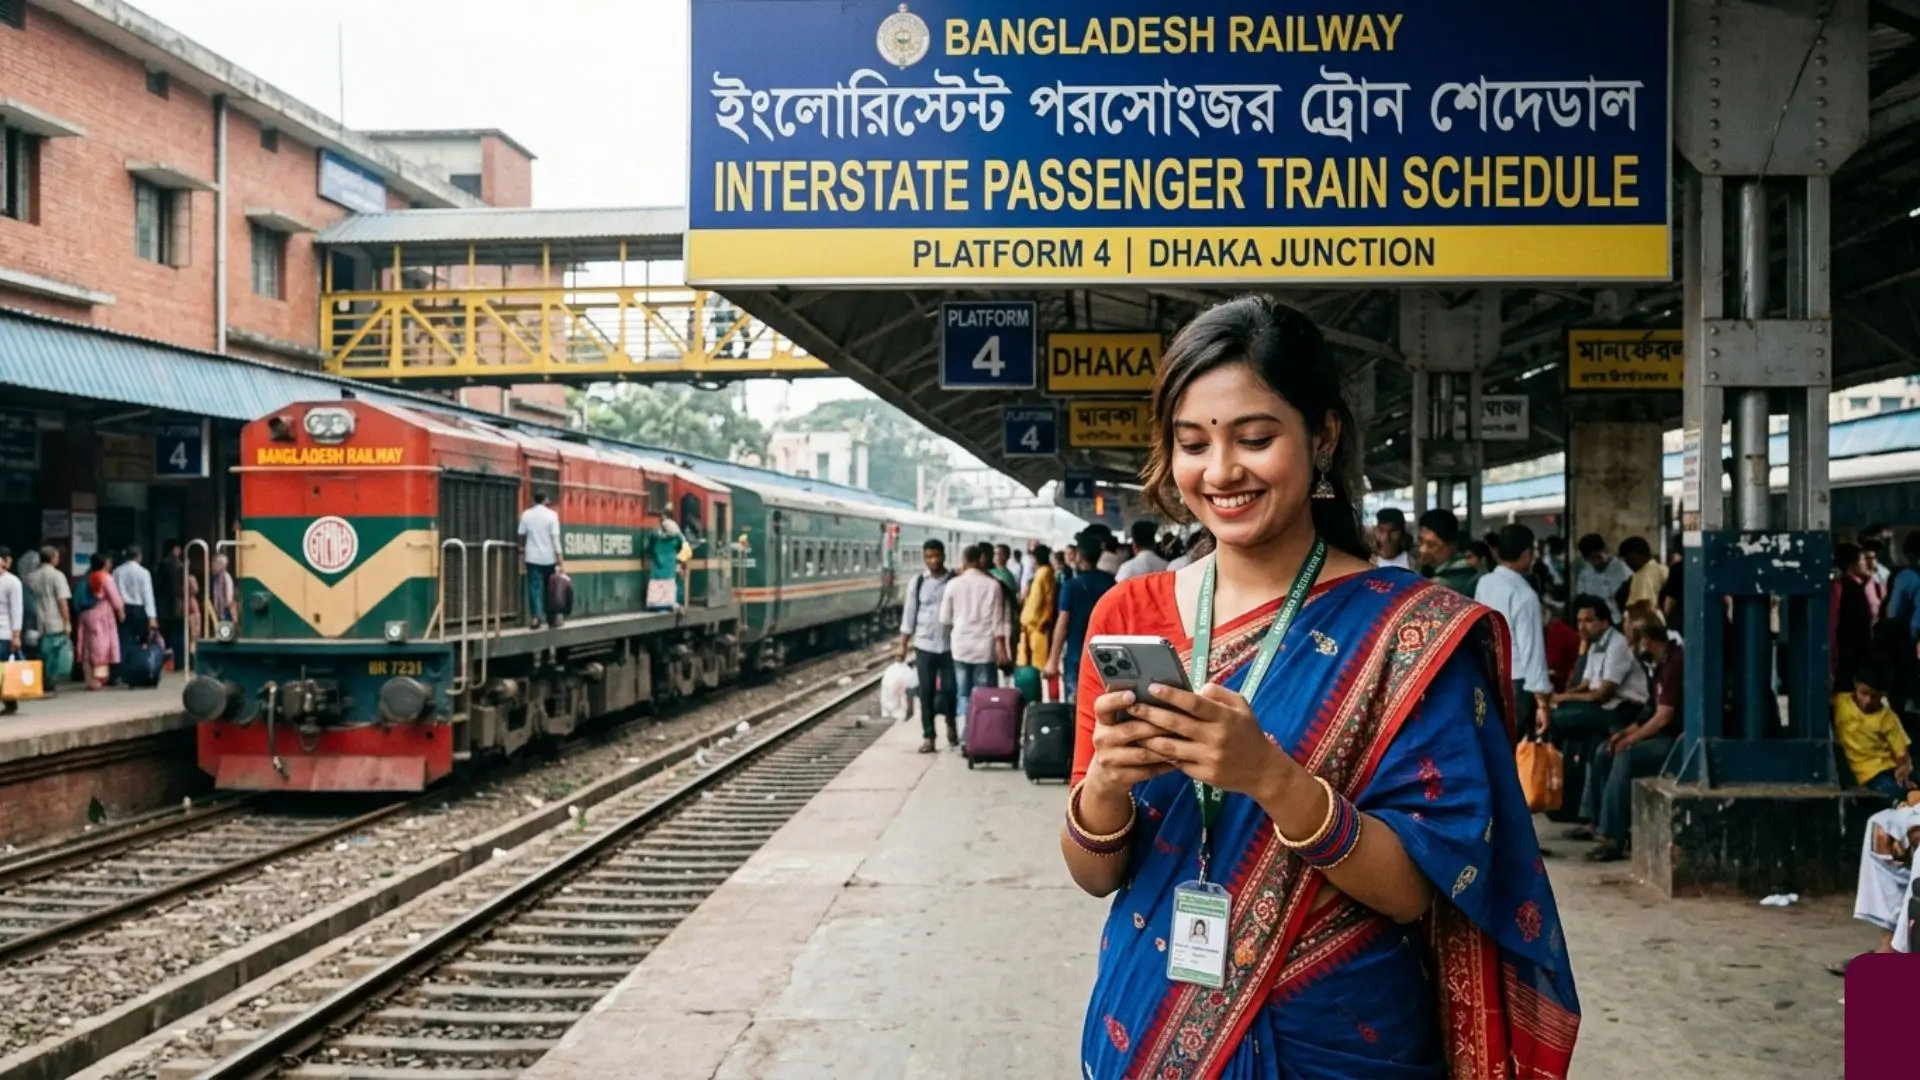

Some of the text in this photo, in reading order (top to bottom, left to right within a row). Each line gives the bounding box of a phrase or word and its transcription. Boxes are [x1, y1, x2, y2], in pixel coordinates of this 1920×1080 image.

[945, 14, 1403, 56] BANGLADESH RAILWAY
[715, 154, 1640, 212] INTERSTATE PASSENGER TRAIN SCHEDULE
[913, 238, 1084, 268] PLATFORM
[1093, 239, 1112, 267] 4
[1148, 237, 1263, 268] DHAKA
[1271, 236, 1436, 268] JUNCTION
[947, 309, 1030, 328] PLATFORM
[971, 334, 1006, 378] 4
[1052, 346, 1157, 377] DHAKA
[1019, 424, 1041, 451] 4
[168, 439, 190, 471] 4
[257, 447, 344, 465] BANGLADESH
